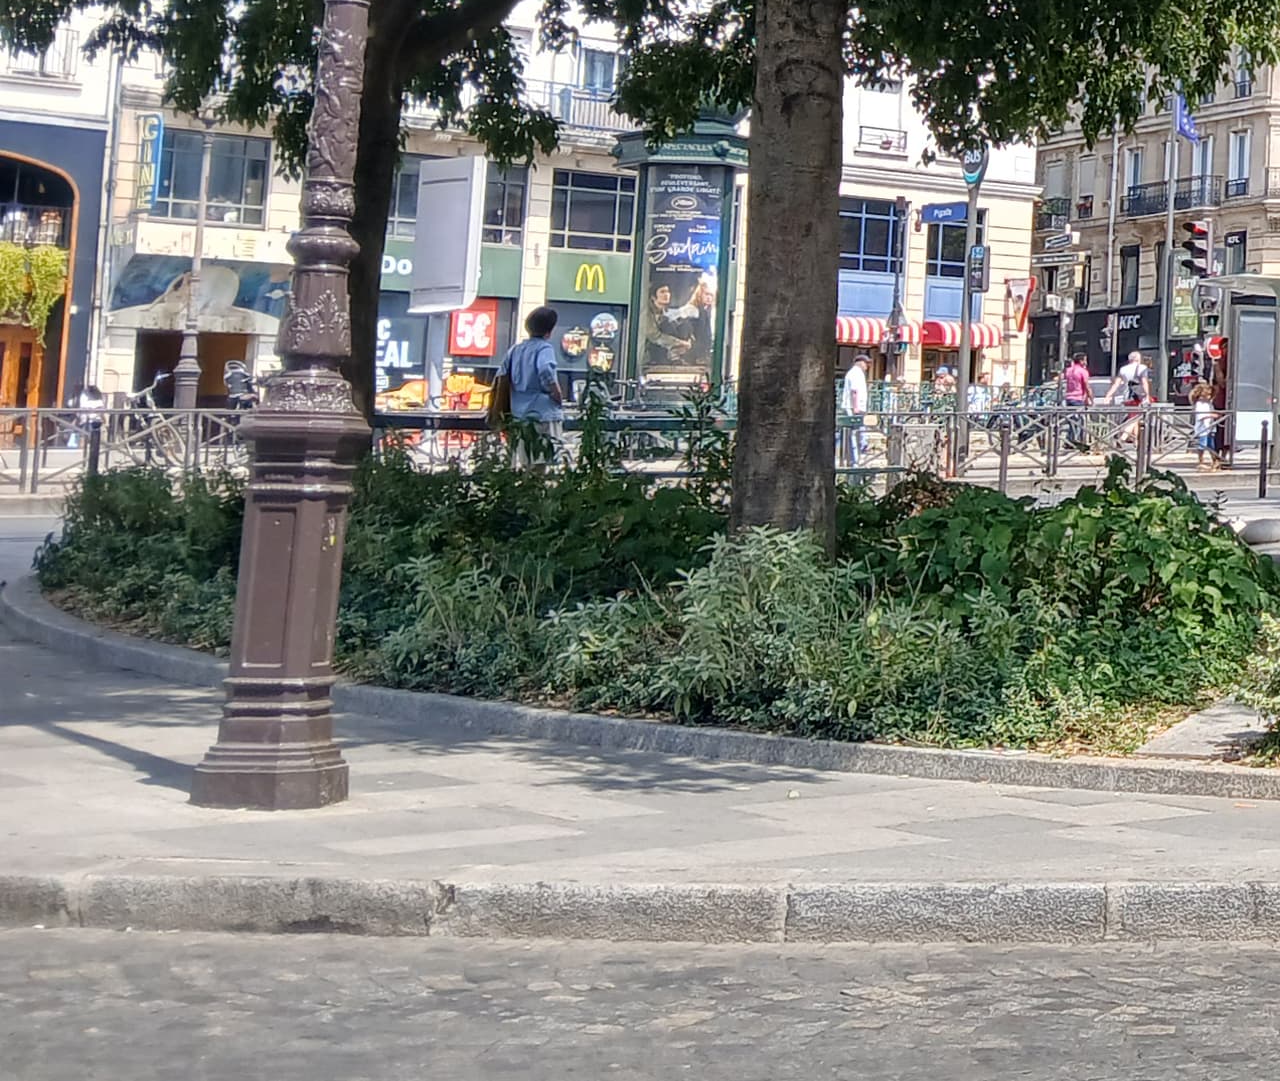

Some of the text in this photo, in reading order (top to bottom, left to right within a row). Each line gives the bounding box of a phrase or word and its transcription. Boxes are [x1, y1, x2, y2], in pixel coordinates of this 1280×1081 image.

[964, 150, 982, 164] BUS
[1119, 314, 1142, 330] KFC
[456, 313, 492, 349] 5€
